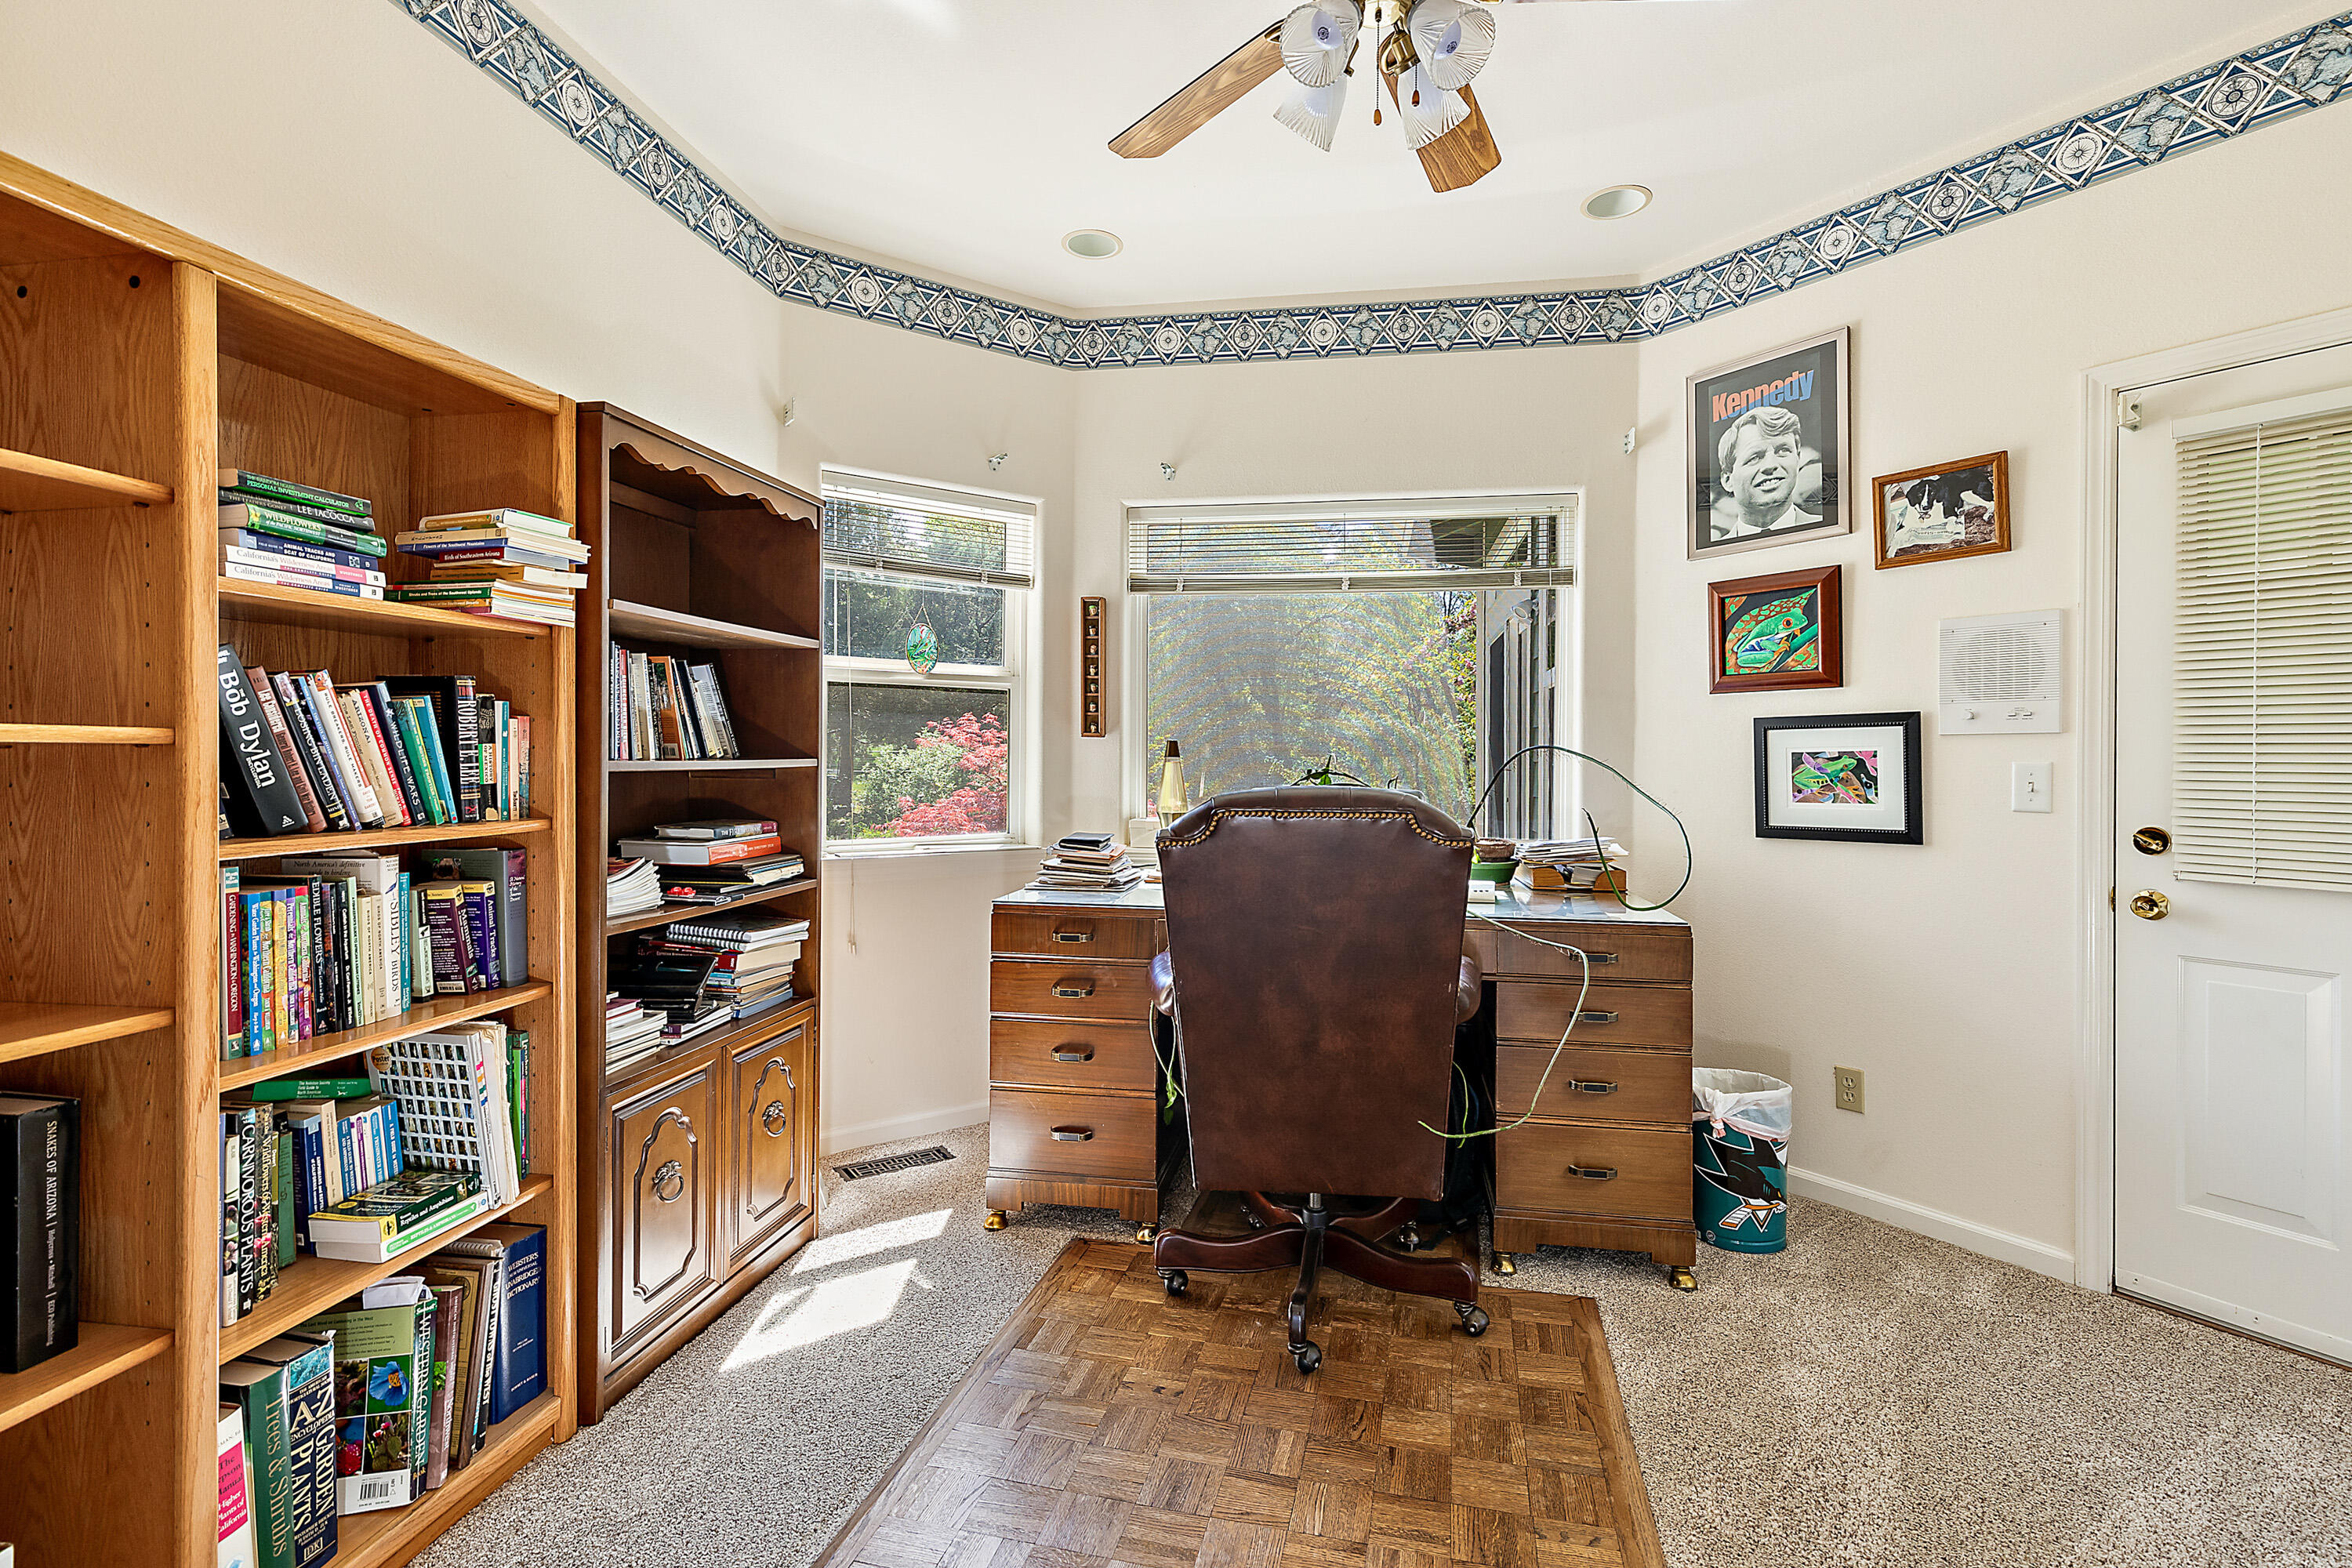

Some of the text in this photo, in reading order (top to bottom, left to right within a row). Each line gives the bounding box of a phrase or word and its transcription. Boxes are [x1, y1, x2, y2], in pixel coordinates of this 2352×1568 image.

[1712, 369, 1814, 423] Kennedy
[246, 480, 278, 492] PERSONAL
[278, 487, 314, 499] INVESTMENT
[314, 495, 349, 508] CALCULATOR
[263, 510, 321, 532] WILDFLOWERS
[296, 504, 356, 524] LEE IACOCCA
[293, 526, 320, 536] NORTHWEST
[236, 548, 333, 572] California's Wilderness Areas
[283, 543, 303, 551] ANIMAL
[303, 546, 324, 555] TRACKS
[306, 553, 336, 564] CALIFORNIA
[234, 564, 330, 587] California's Wilderness Areas
[256, 686, 273, 703] Lee
[220, 669, 277, 788] Bob Dylan
[260, 699, 287, 734] Considered
[456, 699, 479, 746] ROBERT
[293, 707, 315, 746] LOSING
[309, 746, 323, 765] BIN
[317, 765, 337, 800] LADEN
[351, 730, 364, 754] Frontier
[367, 708, 378, 728] DEATH
[375, 729, 381, 738] OF
[378, 739, 390, 765] COMMON
[387, 767, 397, 784] SENSE
[458, 749, 478, 760] E.
[245, 756, 262, 788] ENCYCLOPEDIA
[389, 720, 420, 805] WILDLIFE WARS
[459, 762, 480, 784] LEE
[486, 752, 495, 781] HISTORY
[311, 881, 323, 963] EDIBLE FLOWERS
[390, 902, 399, 955] SIBLEY
[459, 908, 475, 959] Mammals
[487, 899, 497, 957] Animal Tracks
[262, 941, 270, 993] Northern California
[372, 1054, 390, 1063] Poster
[46, 1120, 57, 1158] SNAKES
[46, 1160, 57, 1172] OF
[261, 1135, 271, 1191] Wildflowers
[46, 1177, 57, 1220] ARIZONA
[240, 1124, 254, 1292] CARNIVOROUS PLANTS
[398, 1194, 455, 1227] Reptiles and Amphibians
[259, 1240, 270, 1276] America
[503, 1265, 543, 1289] UNABRIDGED
[504, 1276, 542, 1299] DICTIONARY
[47, 1299, 56, 1313] ECO
[416, 1303, 437, 1315] Sunset
[45, 1313, 56, 1347] Publishing
[481, 1281, 501, 1405] GHOST TOWNS of the WEST
[412, 1313, 432, 1466] WESTERN GARDEN
[290, 1383, 335, 1433] A-Z
[444, 1396, 454, 1450] Northwest
[291, 1410, 335, 1443] ENCYCLOPEDIA
[218, 1456, 235, 1470] The
[265, 1393, 291, 1557] Trees & Shrubs
[315, 1424, 336, 1517] GARDEN
[412, 1467, 426, 1480] Book
[291, 1437, 314, 1532] PLANTS
[237, 1497, 245, 1509] of
